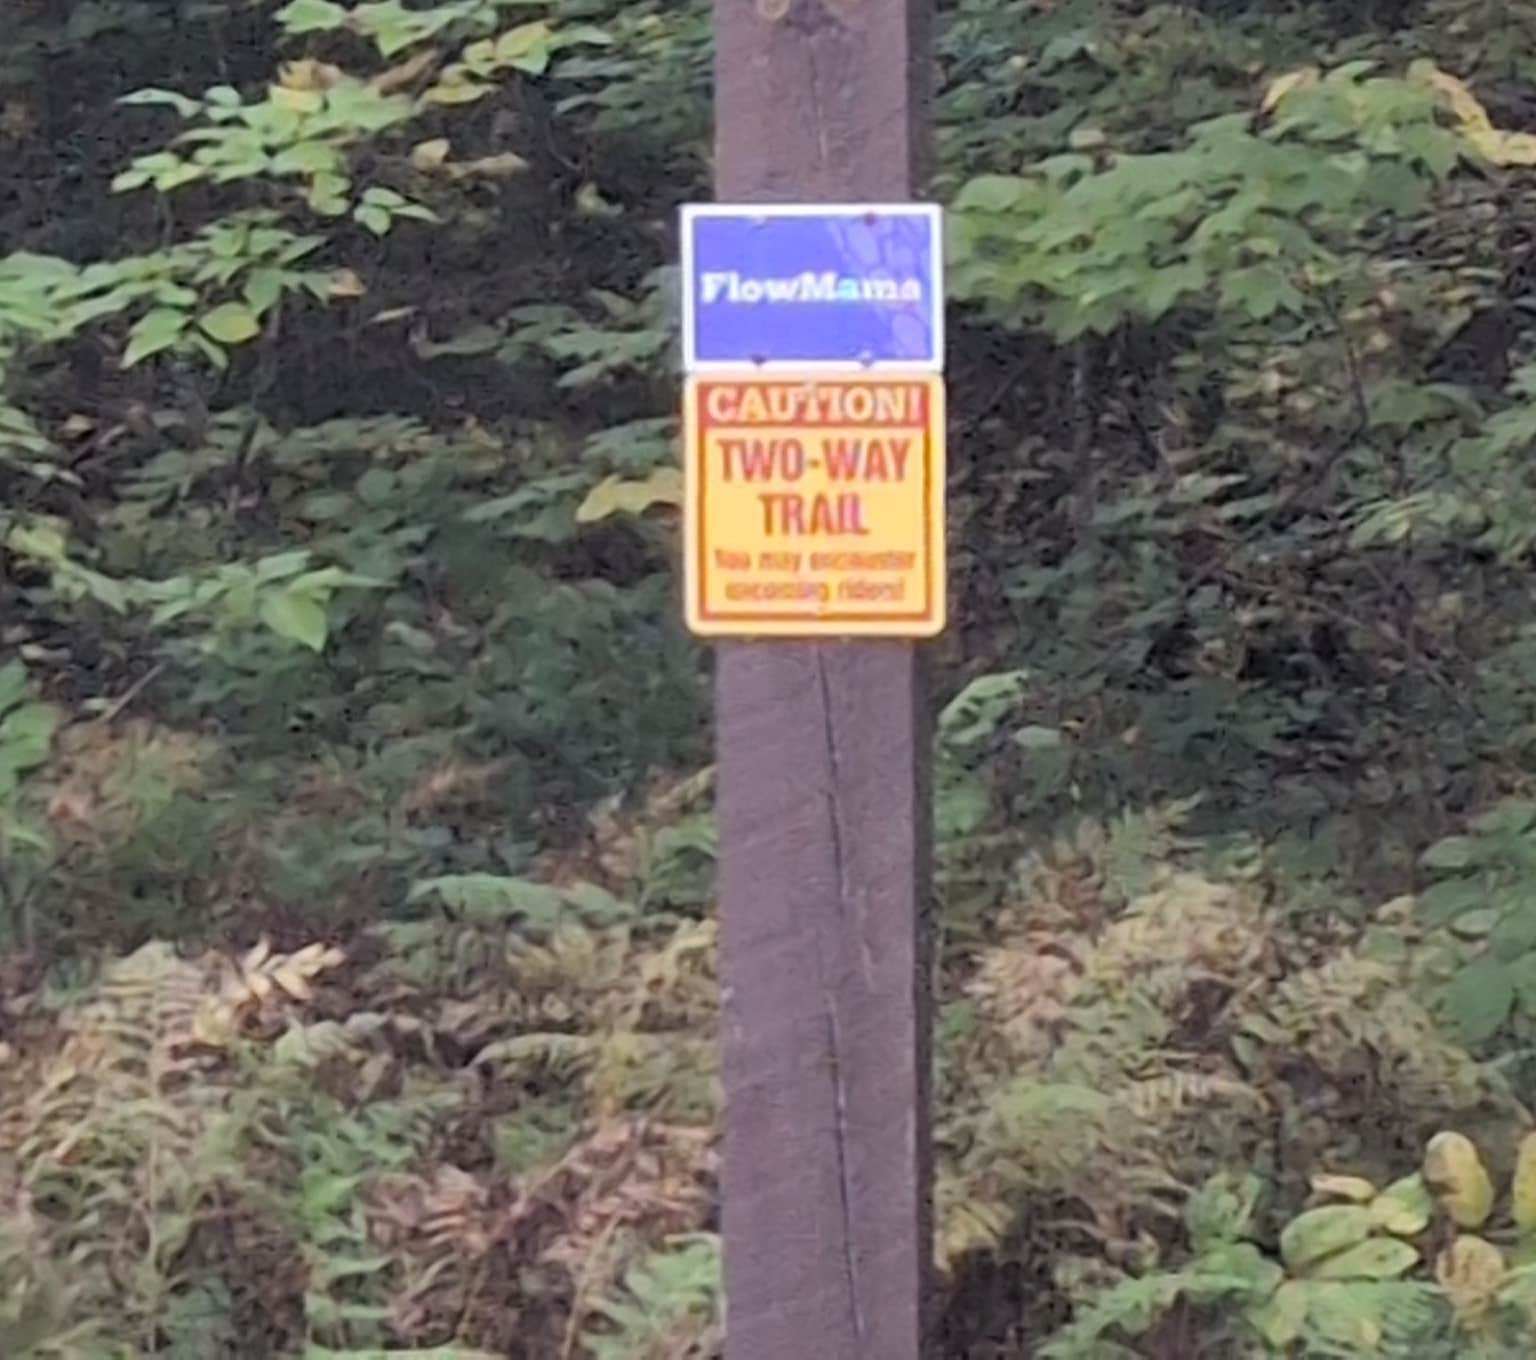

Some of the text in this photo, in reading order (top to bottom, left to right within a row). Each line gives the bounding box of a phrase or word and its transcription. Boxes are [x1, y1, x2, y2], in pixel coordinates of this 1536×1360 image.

[700, 271, 922, 303] FlowMama
[707, 386, 922, 422] CAUTION!
[716, 438, 911, 482] TWO-WAY
[758, 493, 869, 536] TRAIL
